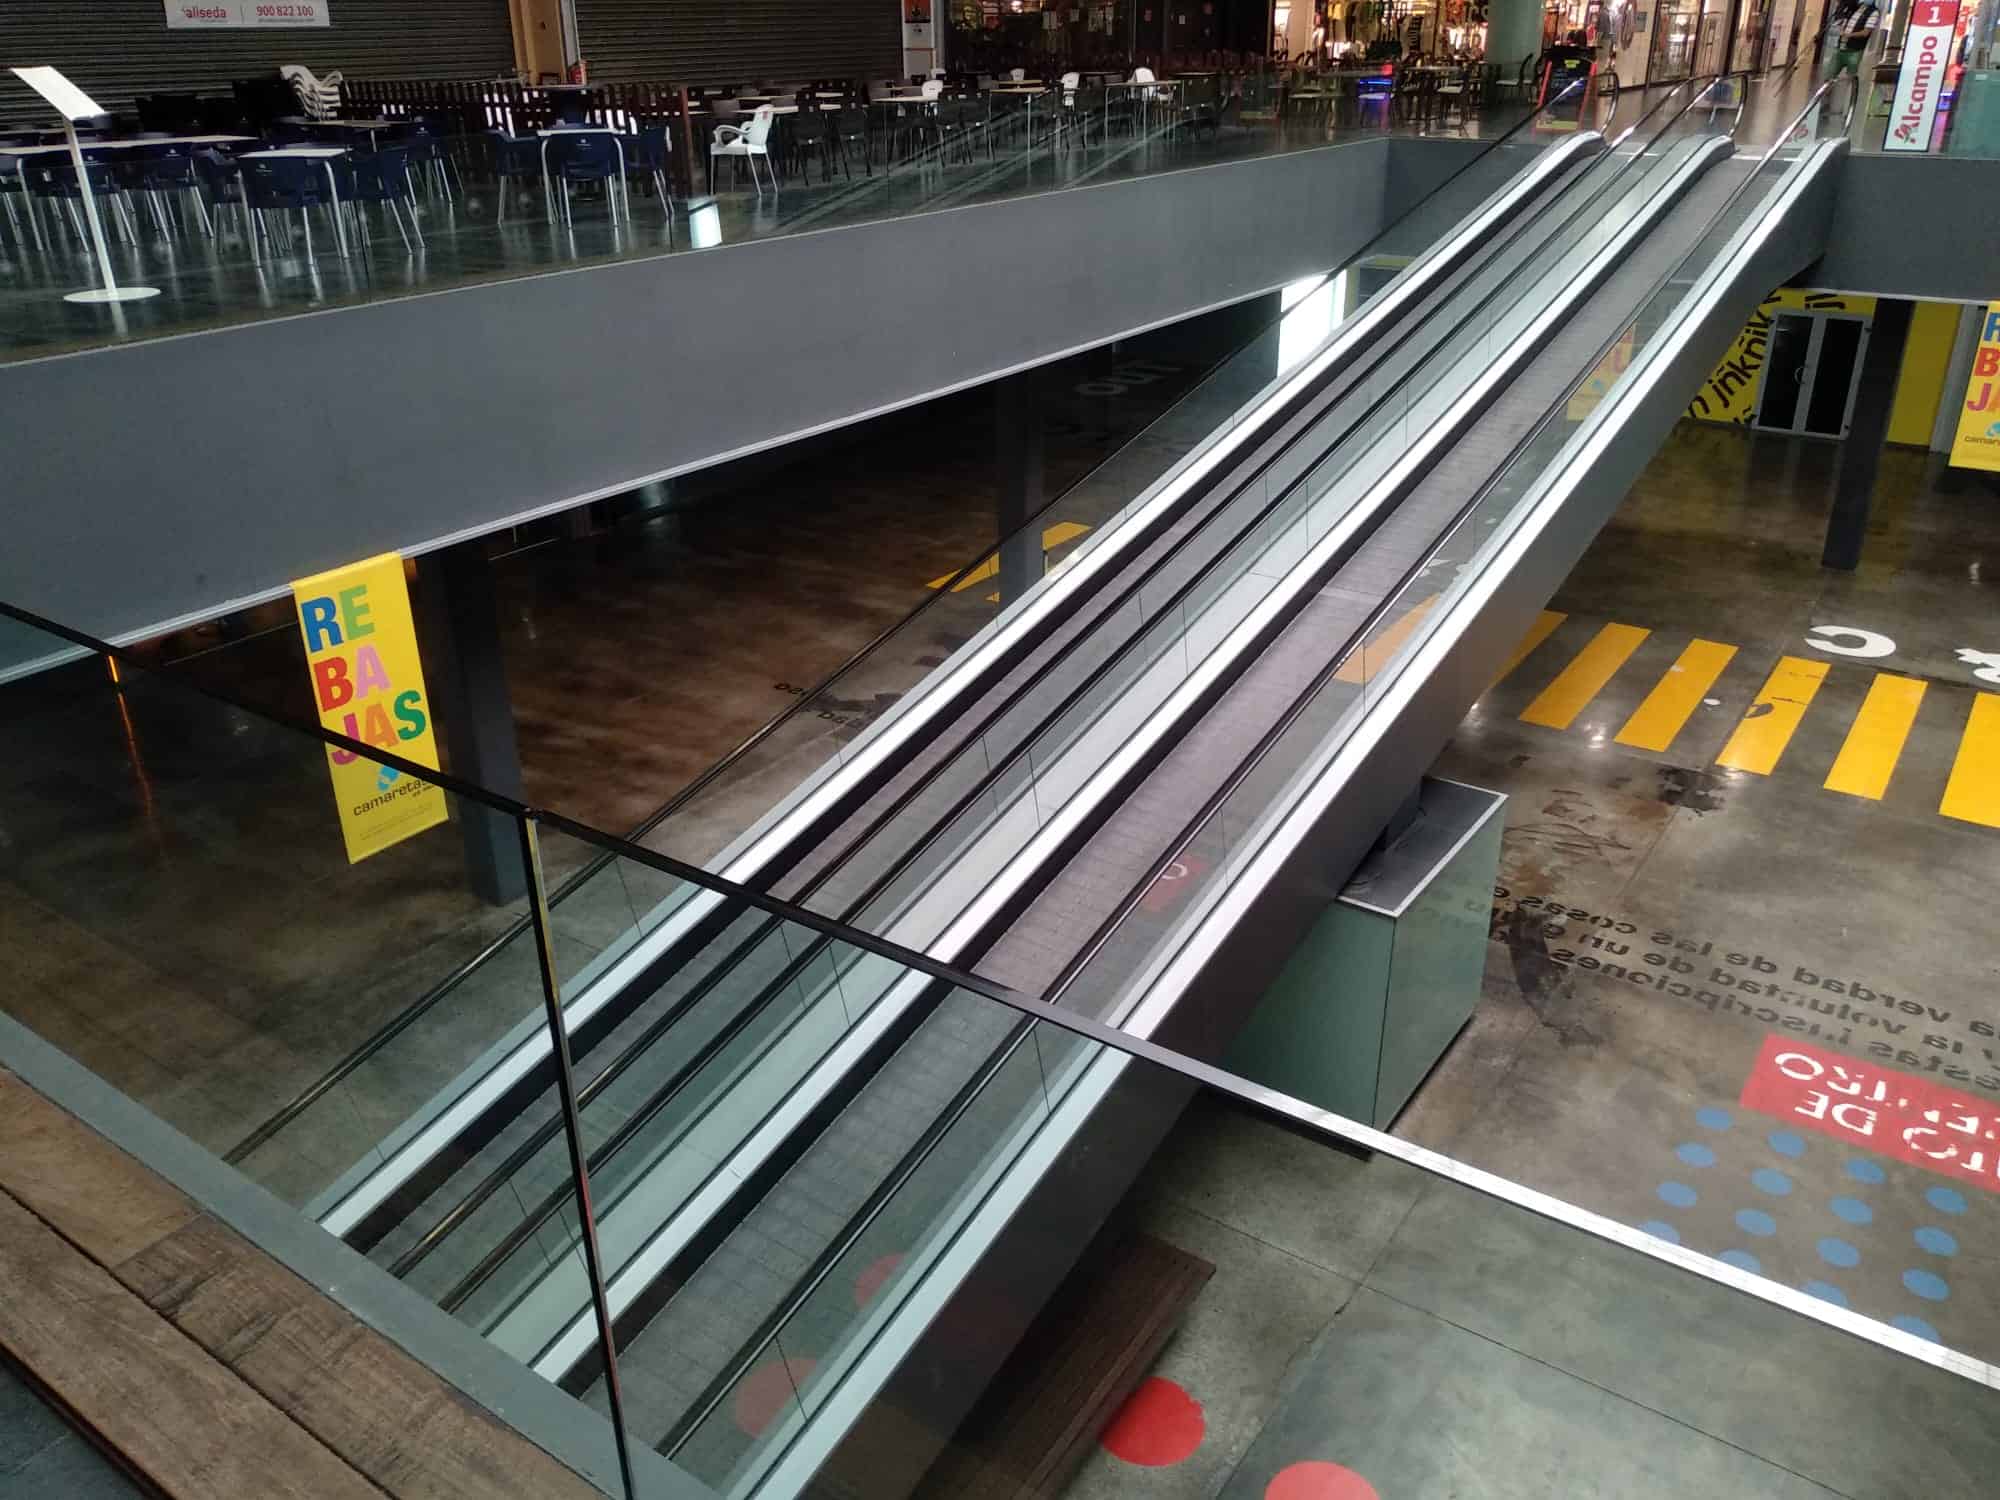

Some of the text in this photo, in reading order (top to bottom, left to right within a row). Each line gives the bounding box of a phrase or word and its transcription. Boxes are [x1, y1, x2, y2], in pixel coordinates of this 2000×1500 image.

[256, 5, 275, 17] 900
[297, 5, 314, 17] 100
[1927, 6, 1940, 23] 1
[1894, 35, 1938, 144] Alcampo
[300, 584, 375, 653] RE
[313, 644, 392, 713] BA
[1795, 1090, 1877, 1136] DE
